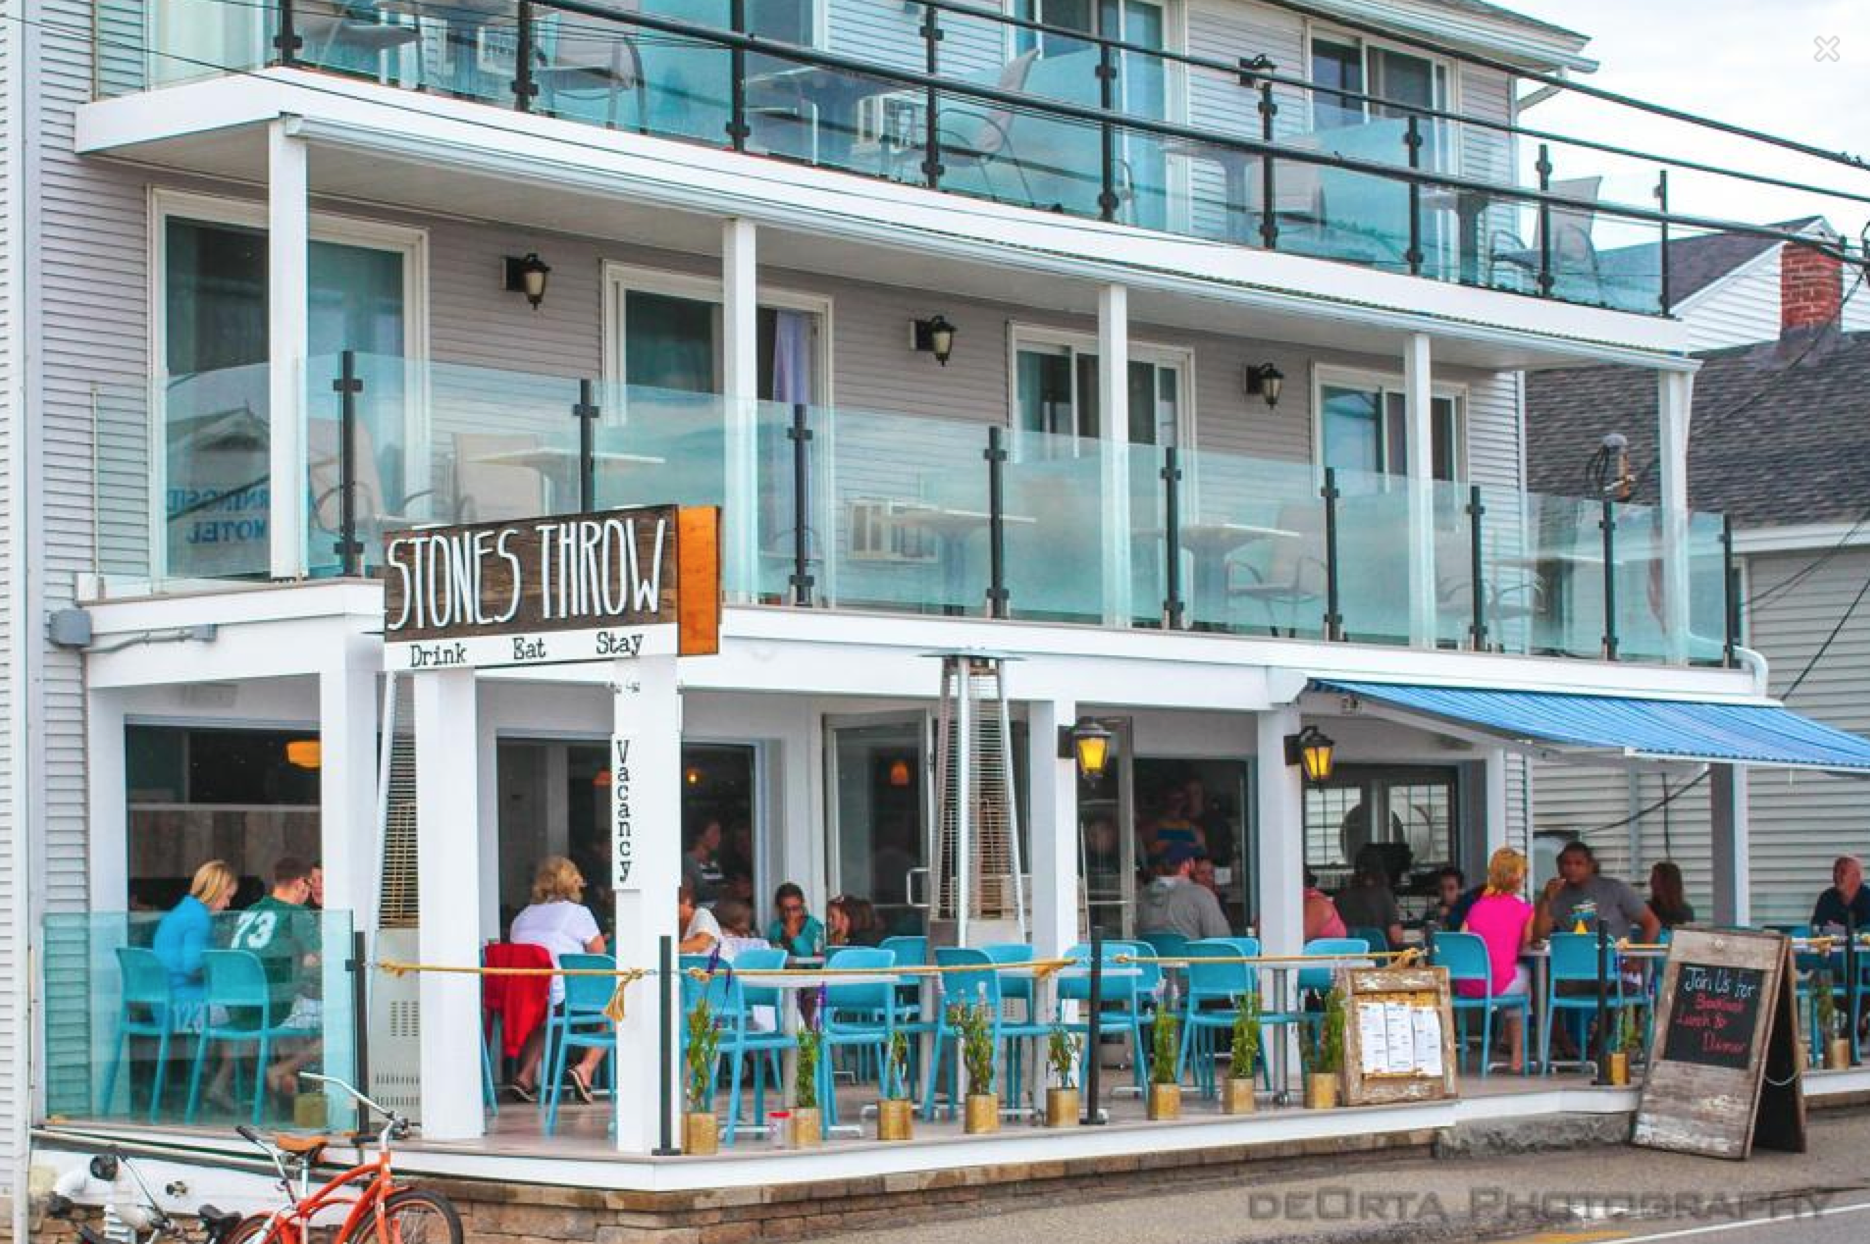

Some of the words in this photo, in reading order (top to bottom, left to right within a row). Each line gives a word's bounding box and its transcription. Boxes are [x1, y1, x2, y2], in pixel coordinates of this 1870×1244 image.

[387, 529, 522, 631] STONES
[535, 518, 666, 620] THROW
[410, 642, 467, 668] Drink
[513, 637, 547, 661] Eat
[596, 631, 643, 656] Stay
[616, 739, 632, 883] Vacancy
[231, 910, 277, 949] 73
